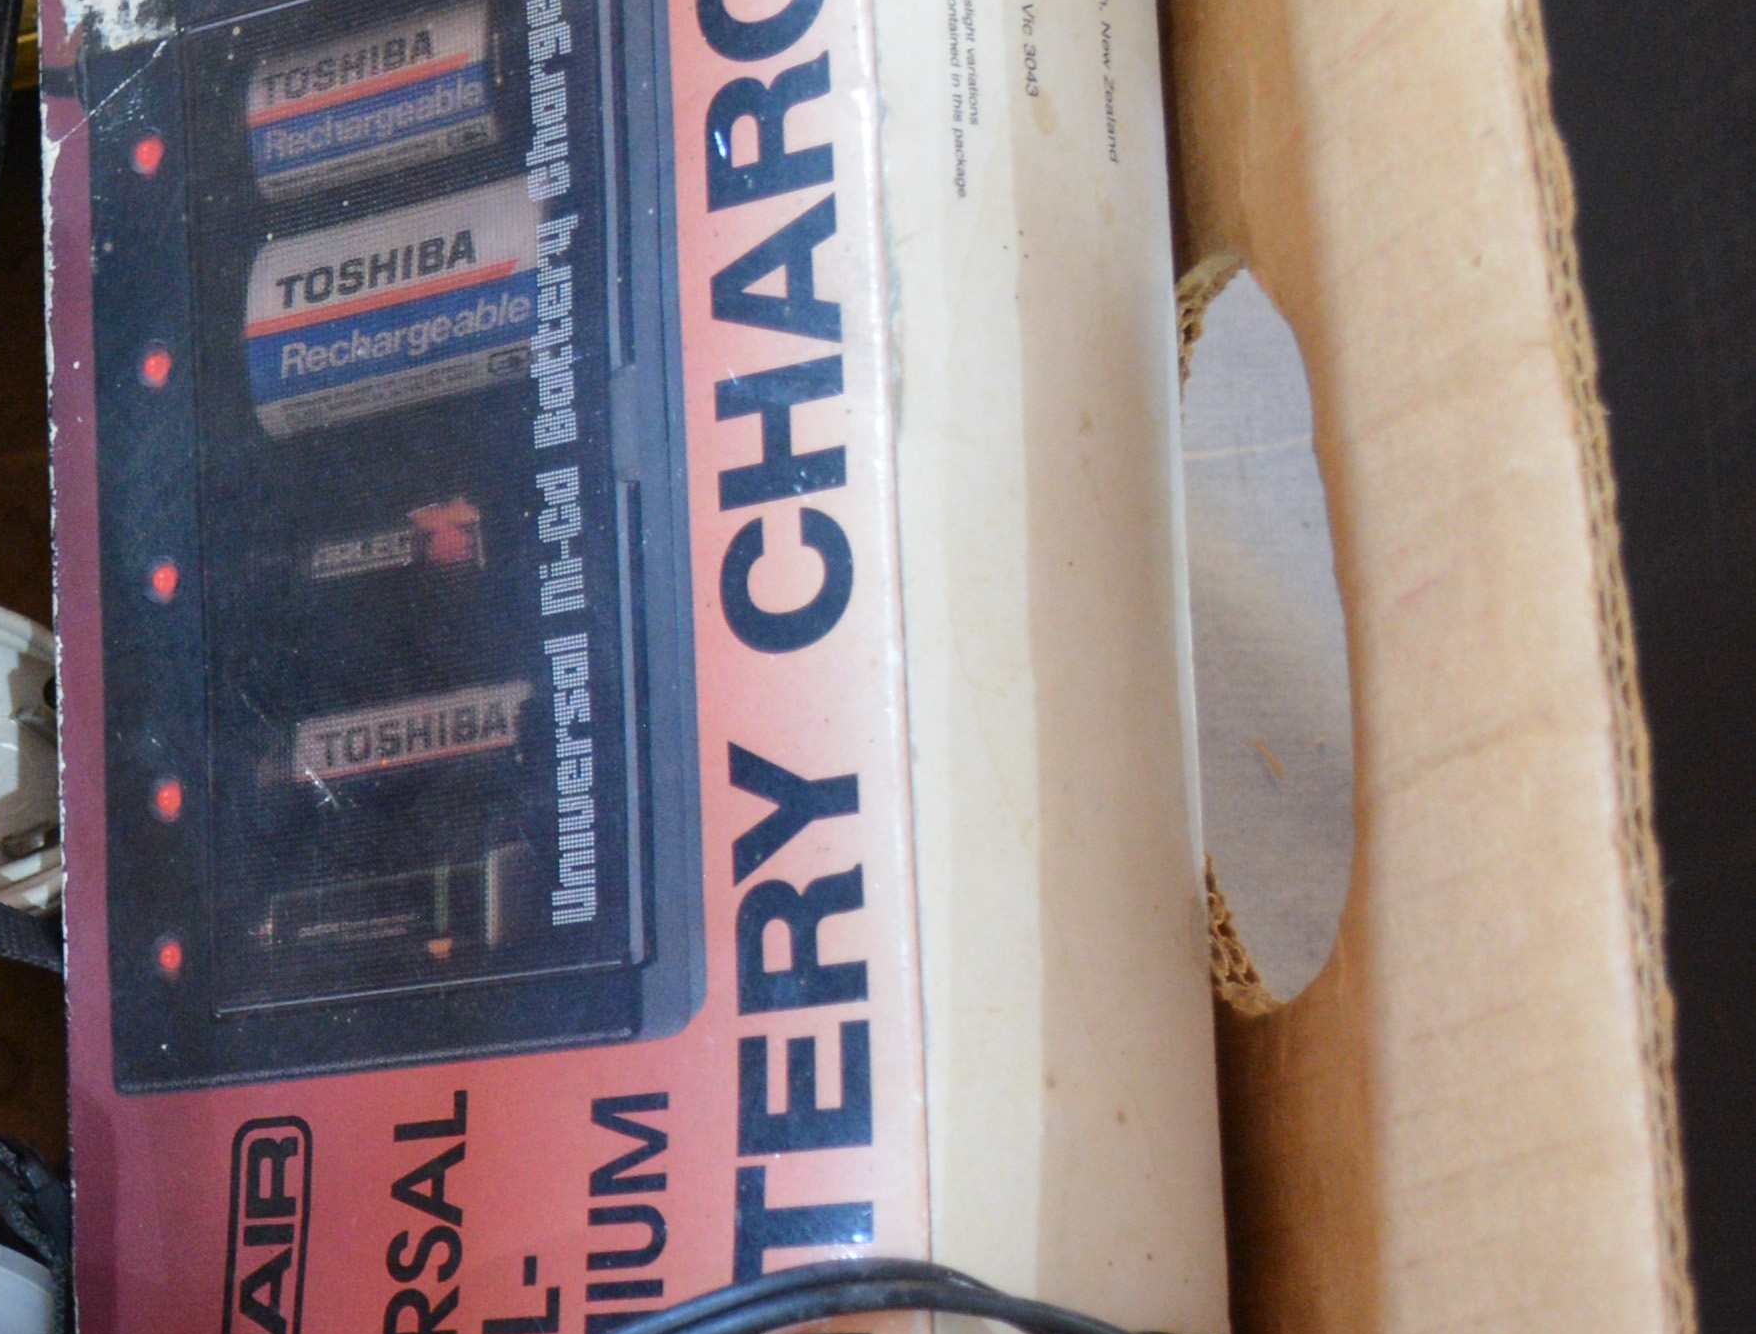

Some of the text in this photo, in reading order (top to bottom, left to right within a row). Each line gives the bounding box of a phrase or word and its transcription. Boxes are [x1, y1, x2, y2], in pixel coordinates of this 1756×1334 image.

[1021, 3, 1034, 37] Vic
[1100, 21, 1112, 67] New
[262, 29, 434, 107] TOSHIBA
[966, 48, 979, 125] variations
[1023, 43, 1039, 98] 3043
[265, 75, 484, 163] Rechargeable
[952, 94, 964, 123] this
[1104, 75, 1120, 164] Zealand
[276, 230, 476, 309] TOSHIBA
[279, 293, 532, 379] Rechargeable
[530, 214, 579, 450] Battery
[535, 466, 586, 616] Ni-Cd
[316, 702, 510, 768] TOSHIBA
[544, 633, 597, 926] Universal
